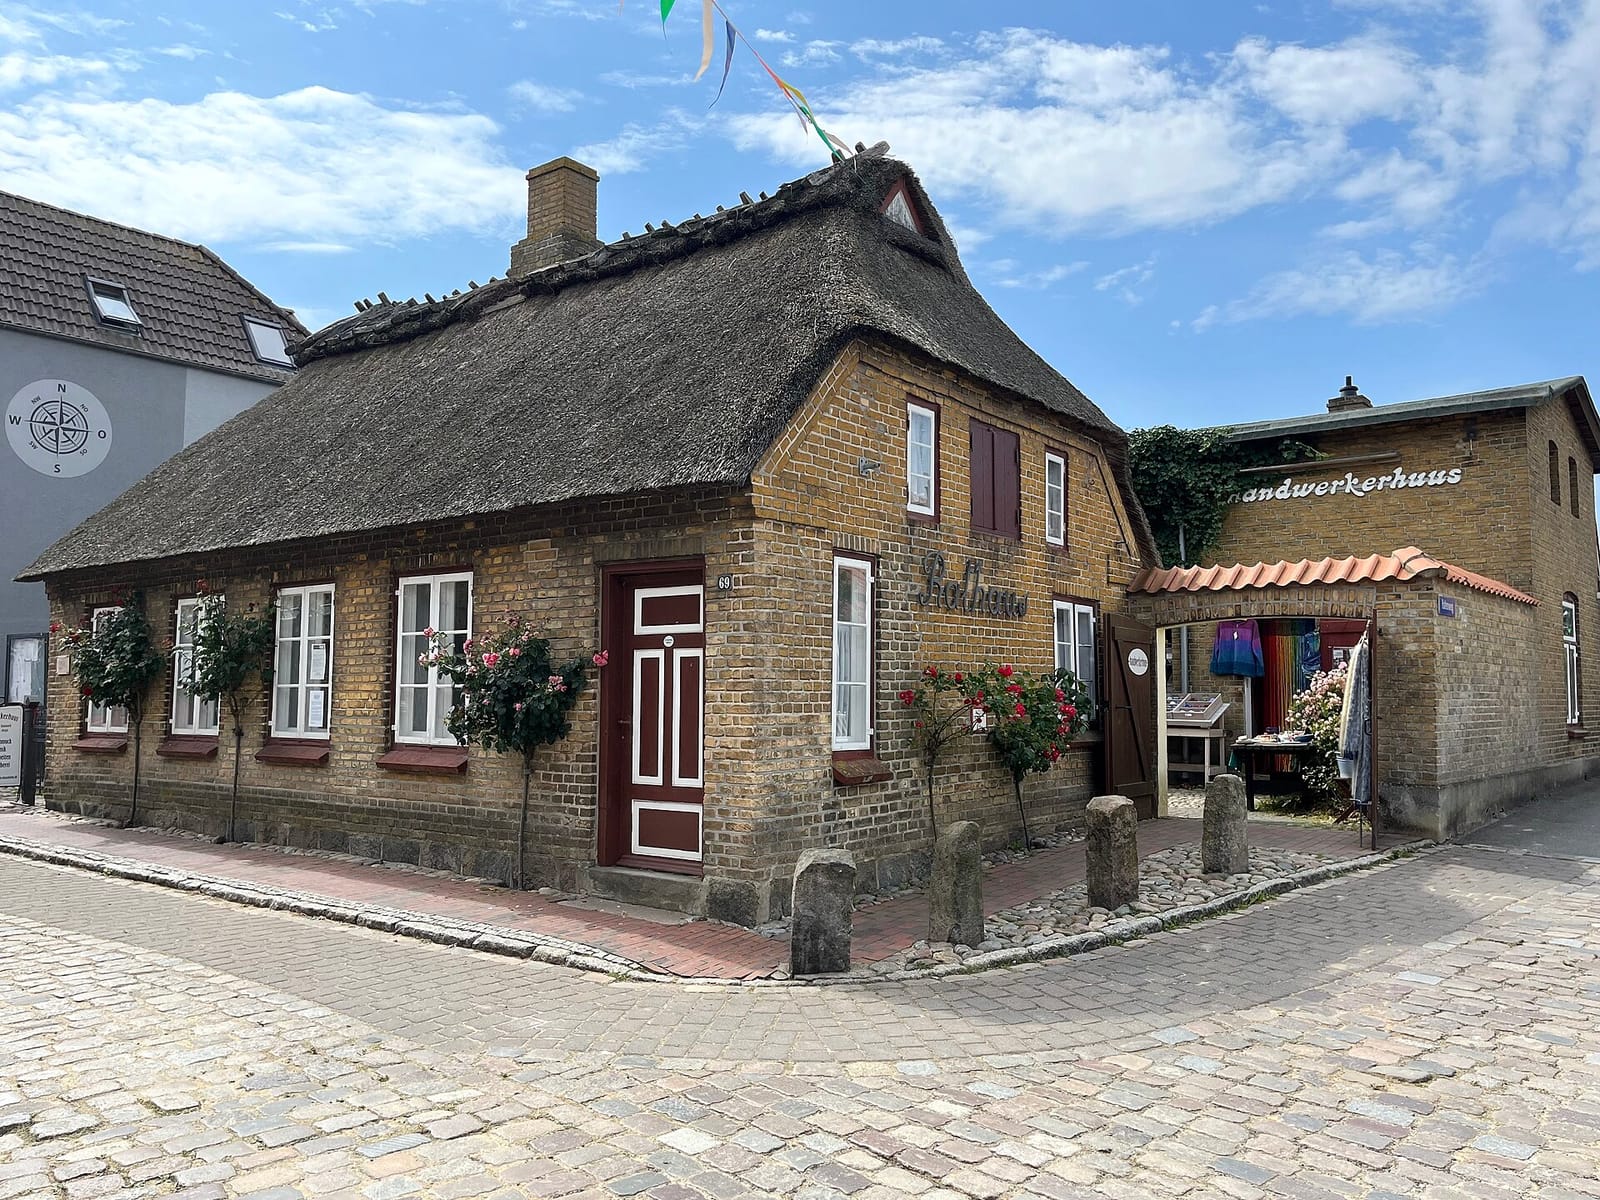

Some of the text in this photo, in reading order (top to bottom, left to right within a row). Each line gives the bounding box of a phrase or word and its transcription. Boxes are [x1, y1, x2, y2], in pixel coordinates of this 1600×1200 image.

[57, 383, 66, 393] N
[31, 395, 42, 405] NW
[79, 403, 89, 413] NO
[9, 415, 22, 425] W
[97, 430, 107, 439] O
[28, 440, 39, 450] SW
[79, 448, 88, 456] SO
[53, 464, 61, 473] S
[718, 576, 730, 589] 69
